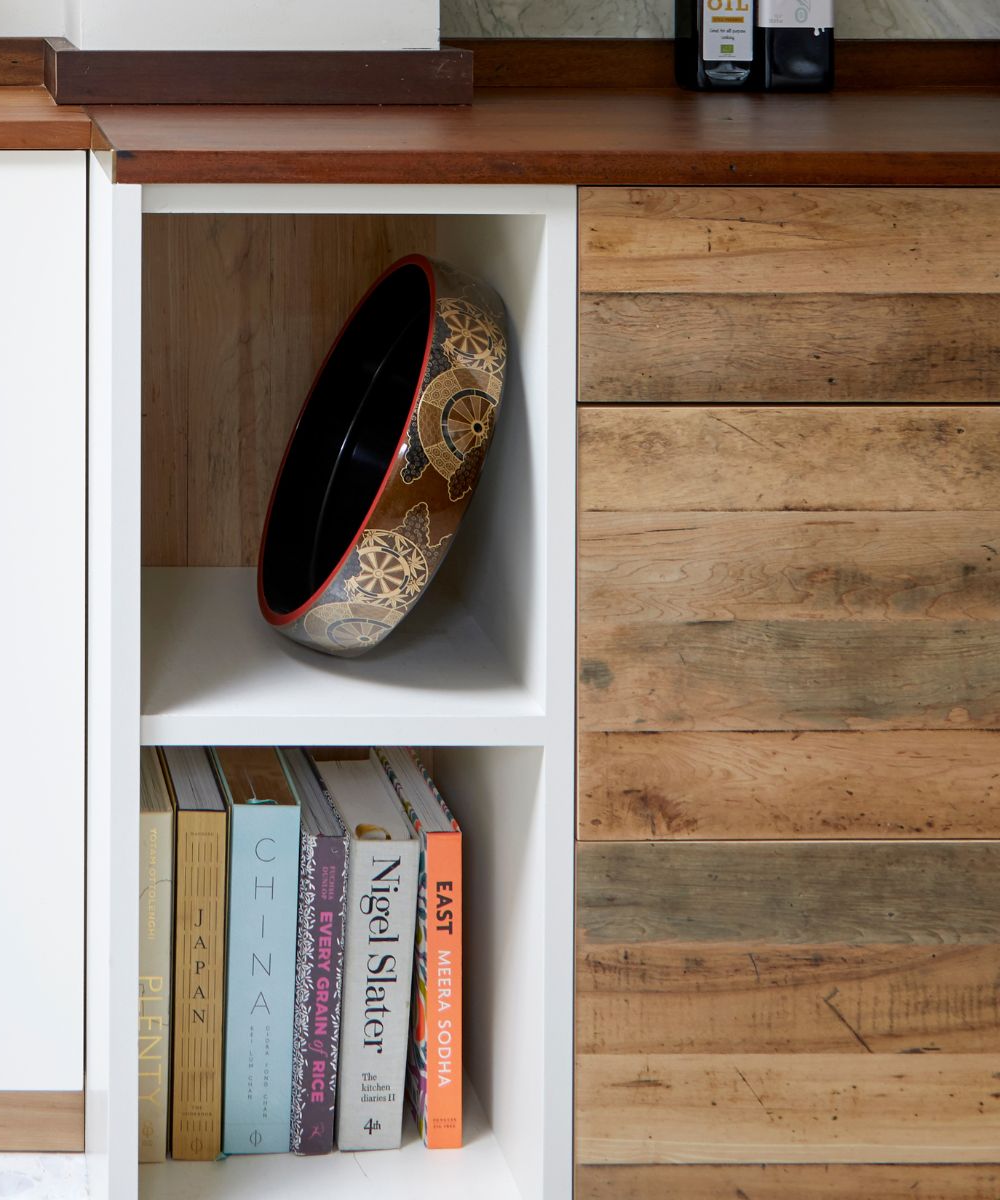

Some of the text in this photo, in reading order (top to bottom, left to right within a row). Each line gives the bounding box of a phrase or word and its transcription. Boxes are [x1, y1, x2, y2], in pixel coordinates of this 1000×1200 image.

[191, 908, 208, 1023] JAPAN
[250, 838, 276, 1015] CHINA
[359, 856, 401, 1054] Nigel Slater
[436, 881, 453, 1087] EAST MEERA SODHA
[309, 912, 334, 1102] EVERY GRAIN of RICE
[361, 1083, 390, 1092] kitchen
[361, 1093, 395, 1102] diaries II
[362, 1072, 377, 1081] The
[363, 1117, 381, 1135] 4th
